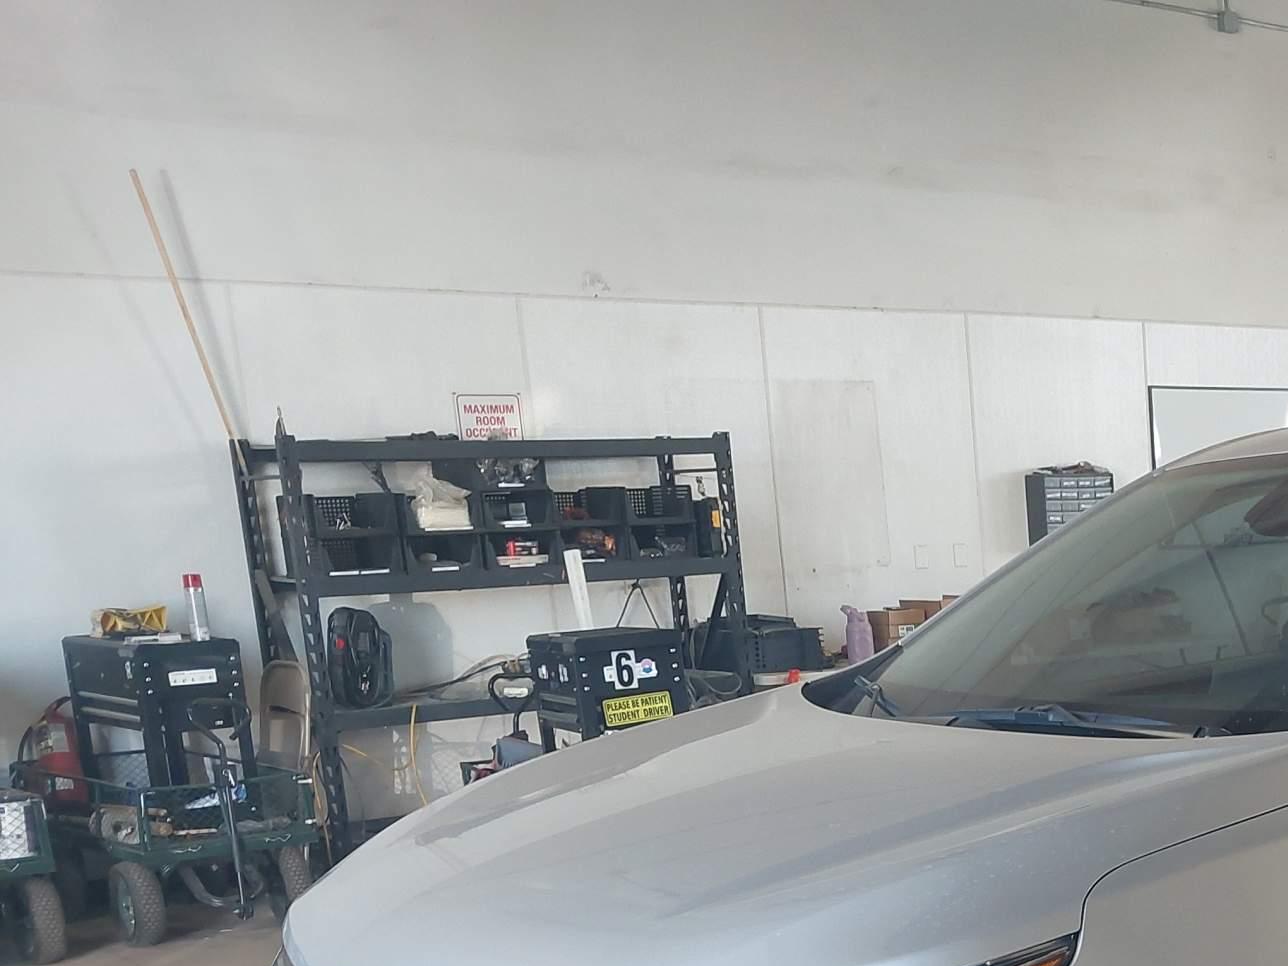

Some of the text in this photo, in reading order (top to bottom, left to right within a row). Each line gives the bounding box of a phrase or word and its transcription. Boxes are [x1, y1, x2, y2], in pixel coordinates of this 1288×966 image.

[463, 404, 515, 415] MAXIMUM
[475, 415, 506, 426] ROOM
[615, 652, 635, 688] 6
[606, 694, 668, 712] PLEASE BE PATIENT
[608, 705, 669, 723] STUDENT DRIVER
